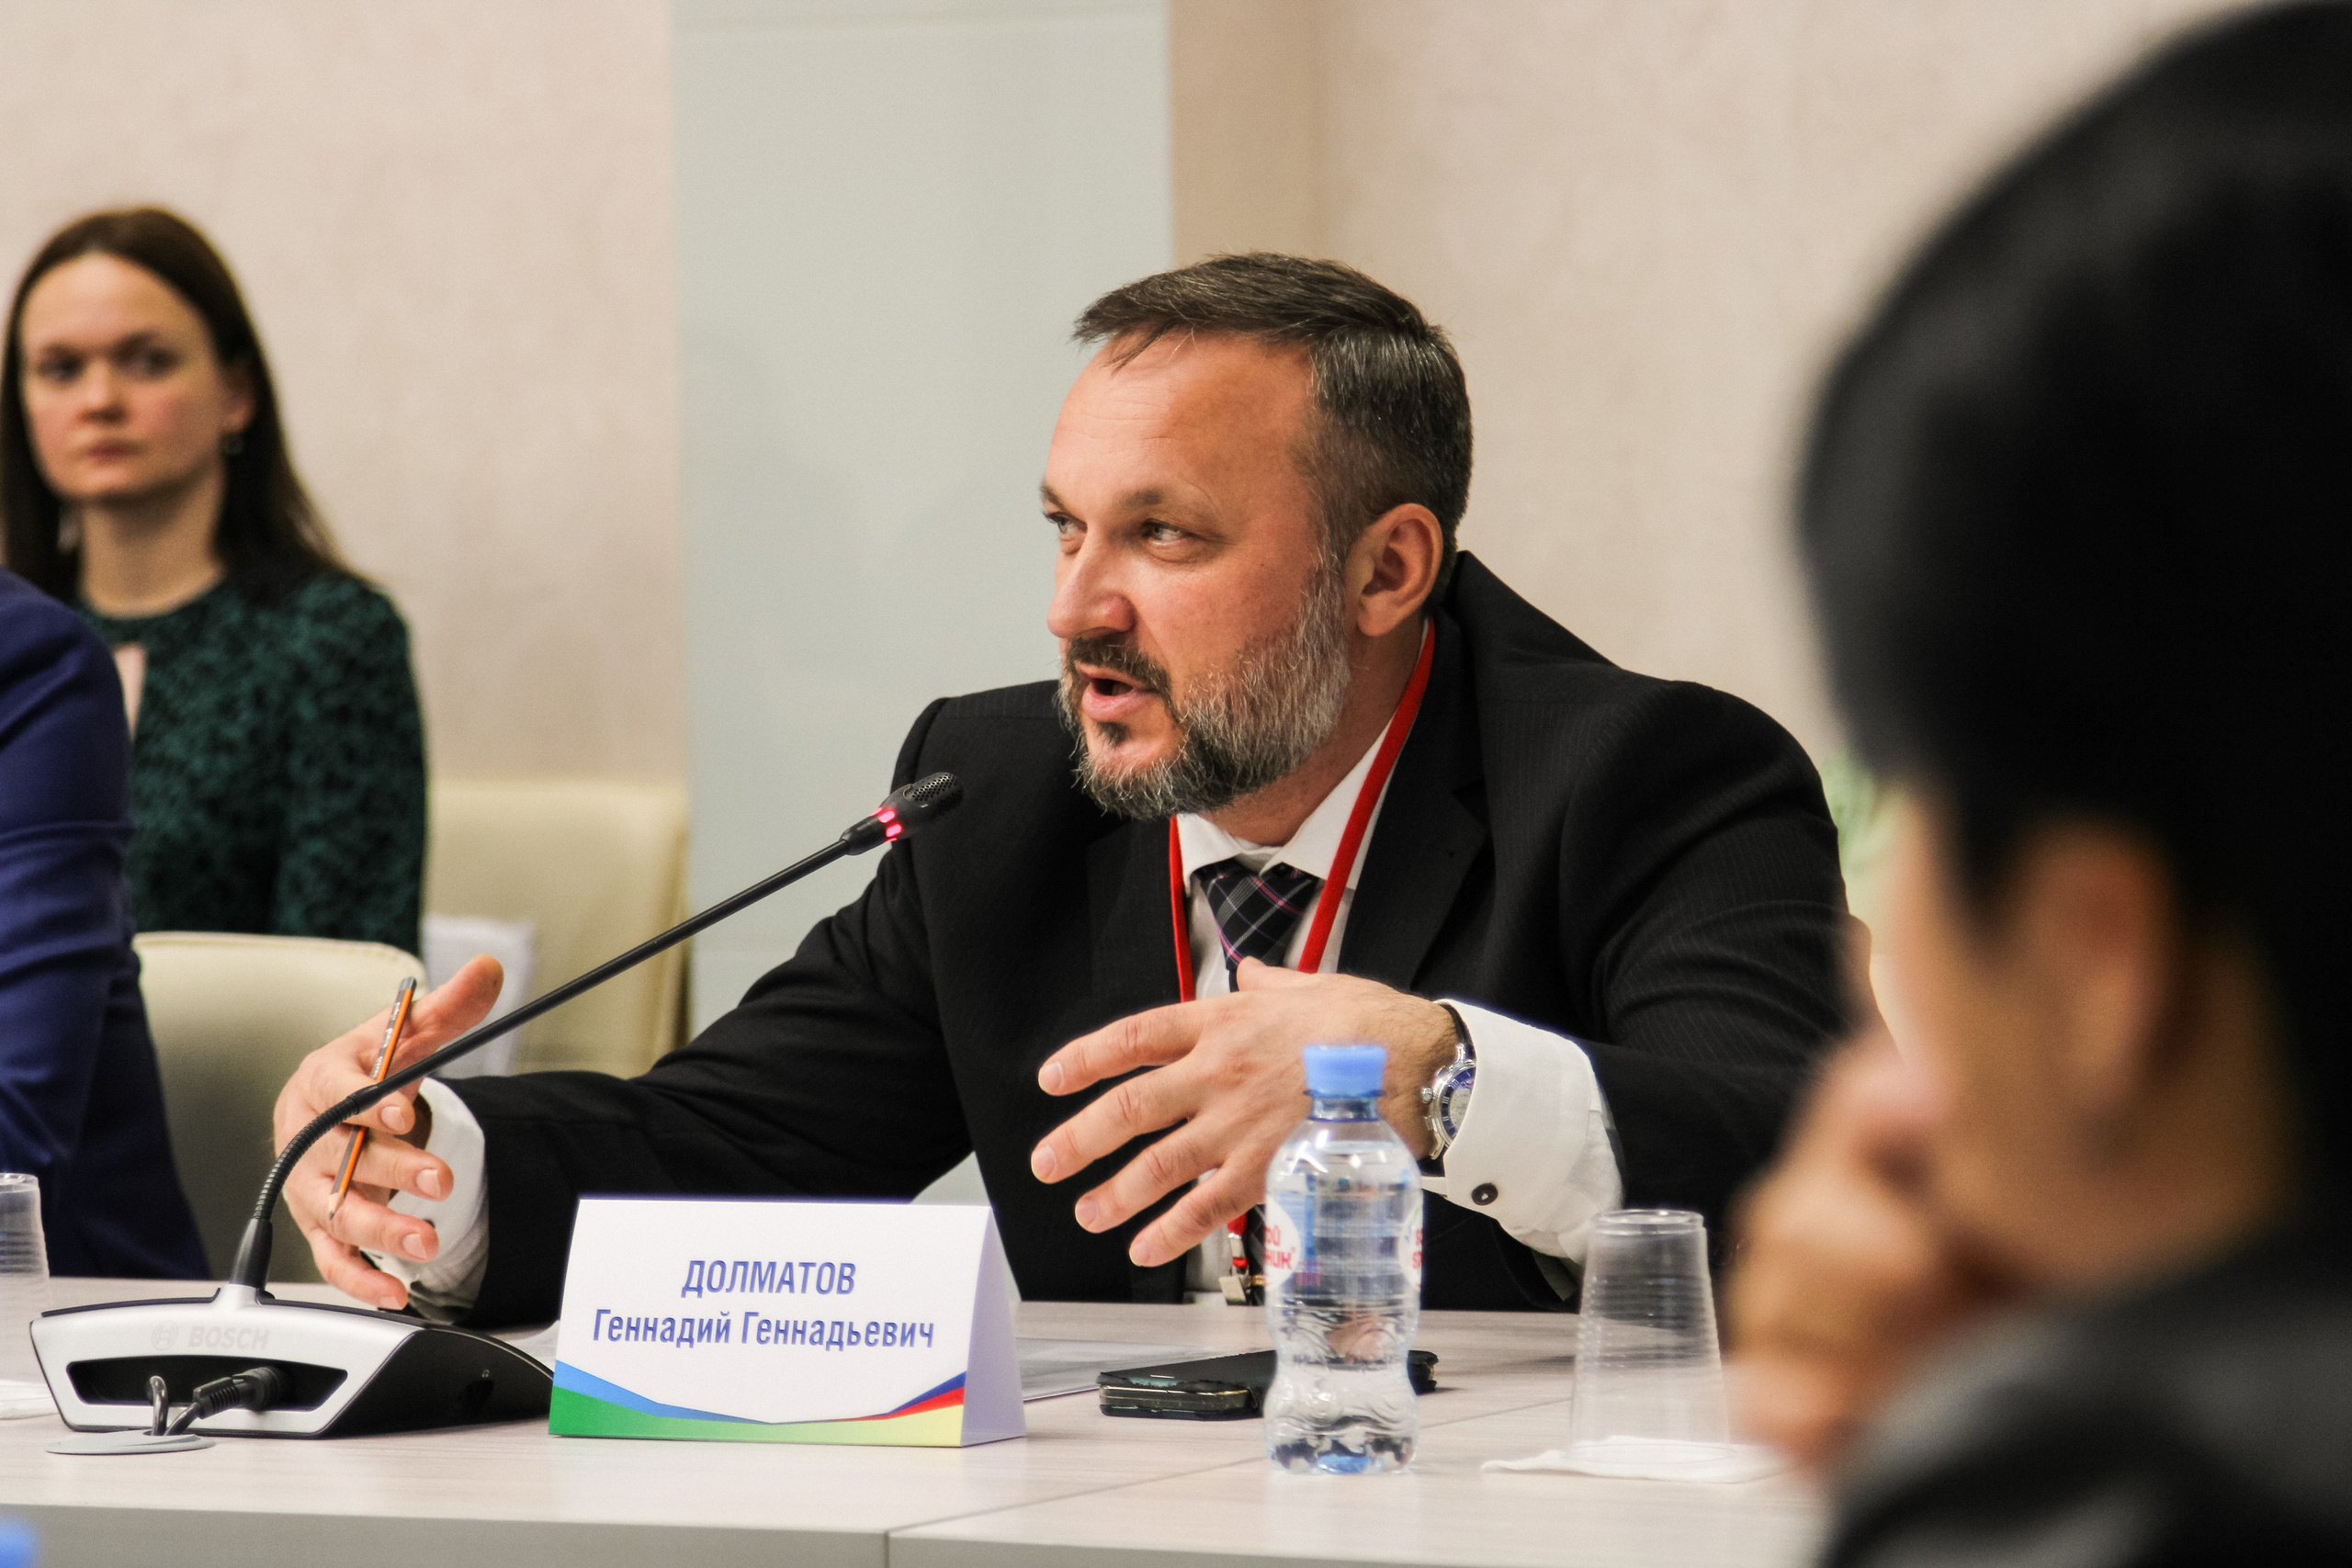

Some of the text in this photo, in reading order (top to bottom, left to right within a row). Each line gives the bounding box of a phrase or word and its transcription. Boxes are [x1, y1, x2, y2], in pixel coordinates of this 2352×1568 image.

[681, 1259, 857, 1298] ДОЛМАТОВ
[187, 1325, 271, 1350] BOSCH
[593, 1308, 935, 1351] Геннадий Геннадьевич
